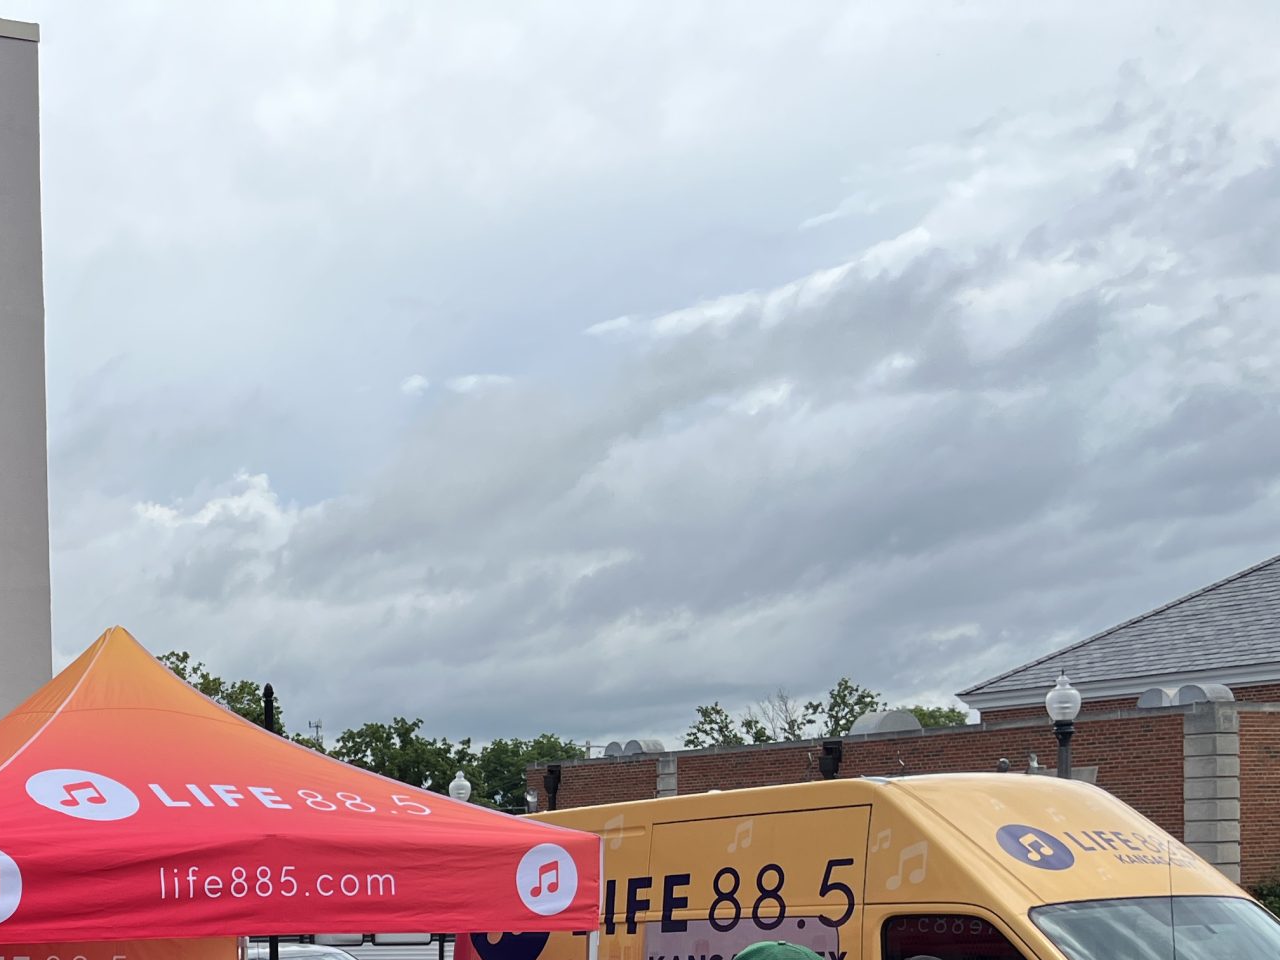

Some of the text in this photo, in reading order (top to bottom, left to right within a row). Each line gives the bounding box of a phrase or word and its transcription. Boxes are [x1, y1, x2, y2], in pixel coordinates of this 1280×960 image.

[148, 783, 432, 816] LIFE 88.5
[1063, 830, 1141, 853] LIFE
[160, 866, 396, 899] life885.com
[573, 858, 856, 936] IFE 88.5
